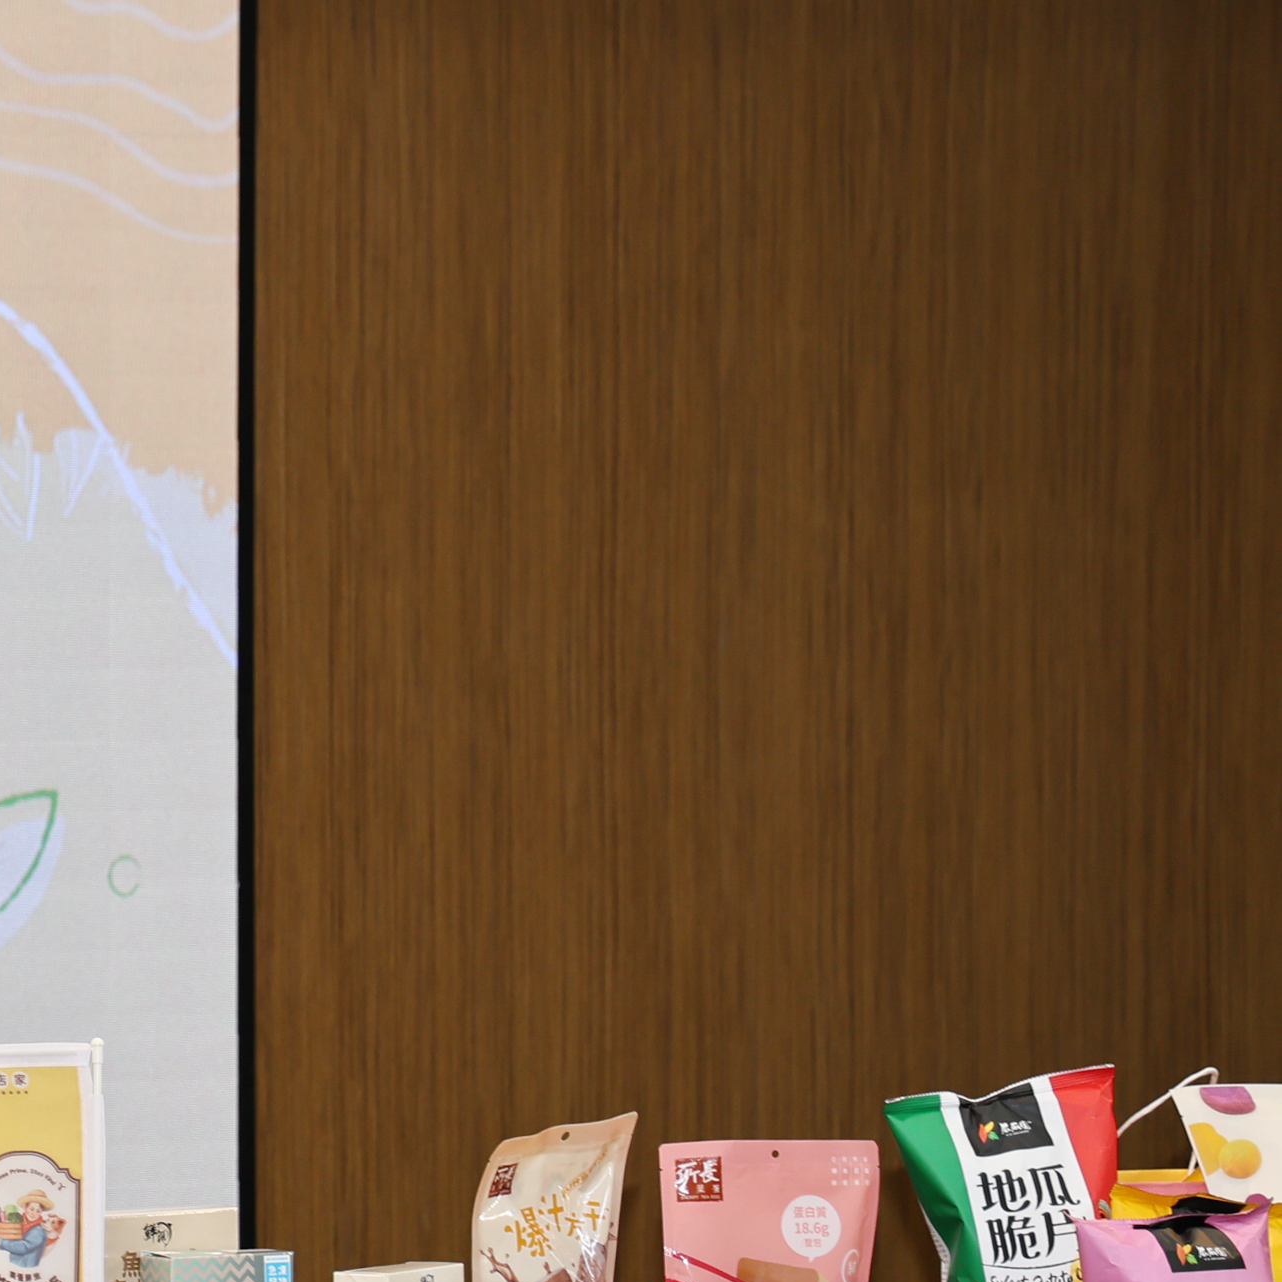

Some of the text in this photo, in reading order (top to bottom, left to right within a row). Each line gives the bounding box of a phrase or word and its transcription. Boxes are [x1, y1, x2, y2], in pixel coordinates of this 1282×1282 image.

[976, 1164, 1081, 1212] 地瓜
[793, 1206, 827, 1218] 蛋白質
[795, 1222, 830, 1237] 18.6g
[987, 1209, 1082, 1266] 脆片
